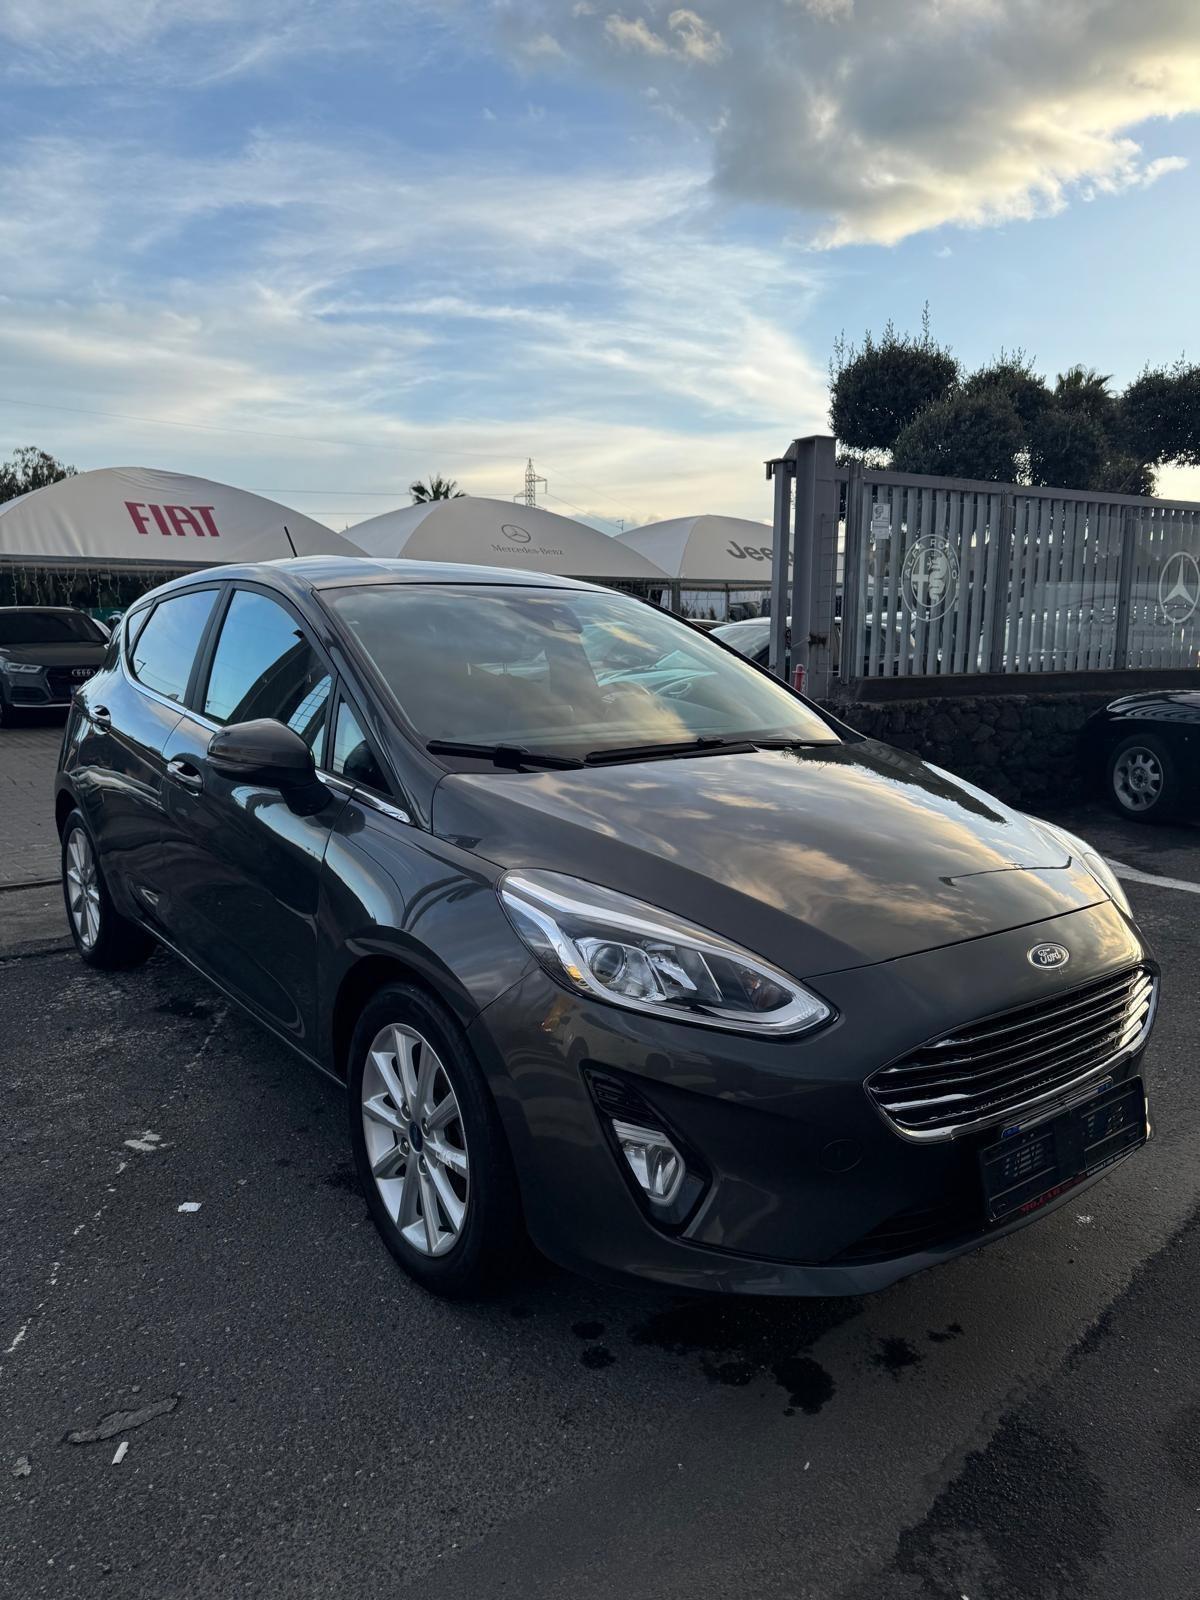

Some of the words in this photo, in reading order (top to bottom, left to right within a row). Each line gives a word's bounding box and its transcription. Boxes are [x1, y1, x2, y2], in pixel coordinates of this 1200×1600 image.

[125, 502, 220, 537] FIAT
[491, 544, 563, 556] Mercedes-Benz
[905, 543, 926, 578] ALFA
[930, 539, 957, 580] ROMEO
[1037, 948, 1061, 964] Ford
